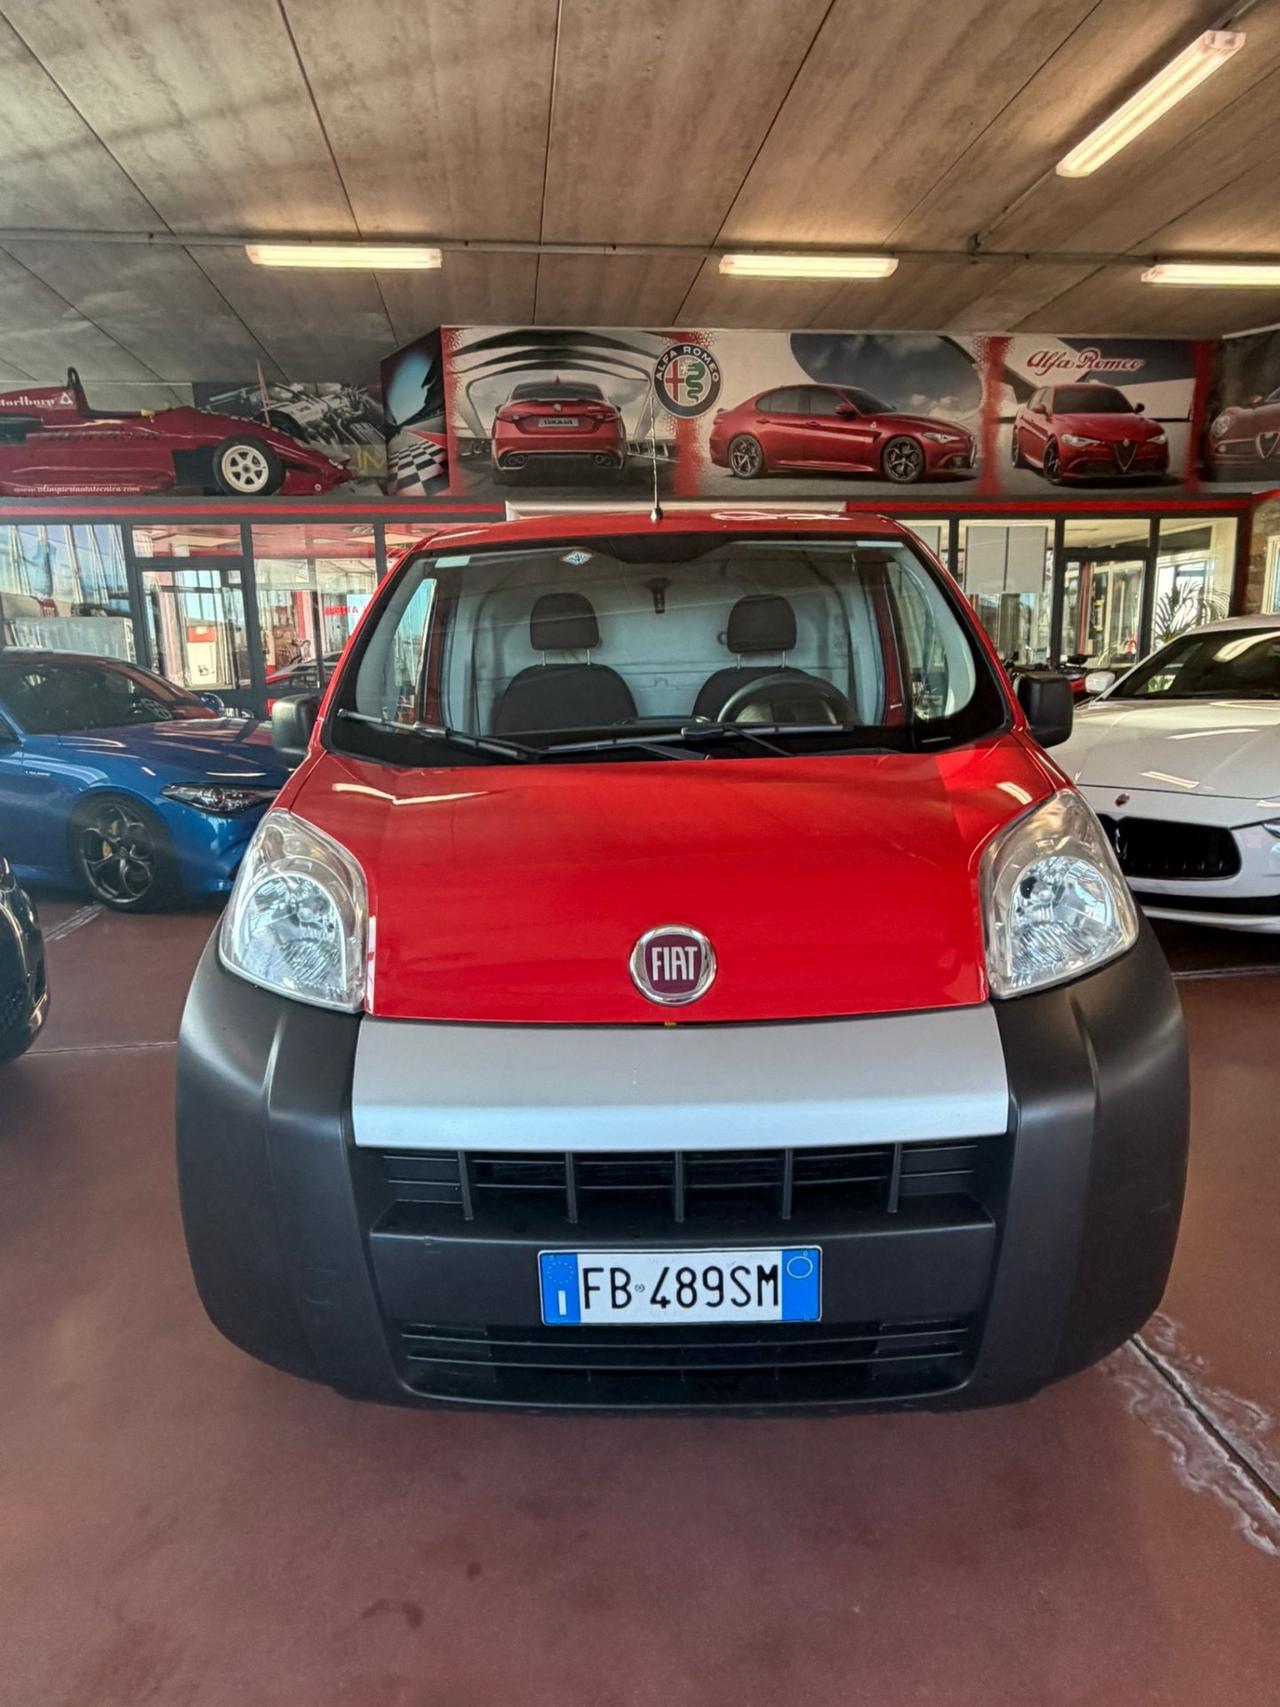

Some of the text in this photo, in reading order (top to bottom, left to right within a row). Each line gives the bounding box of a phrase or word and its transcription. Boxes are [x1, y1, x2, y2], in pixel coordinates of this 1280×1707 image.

[655, 345, 720, 382] ALFA ROMEO
[1026, 347, 1145, 376] Alfa Romeo
[651, 946, 698, 982] FIAT
[582, 1264, 779, 1309] FB 489SM
